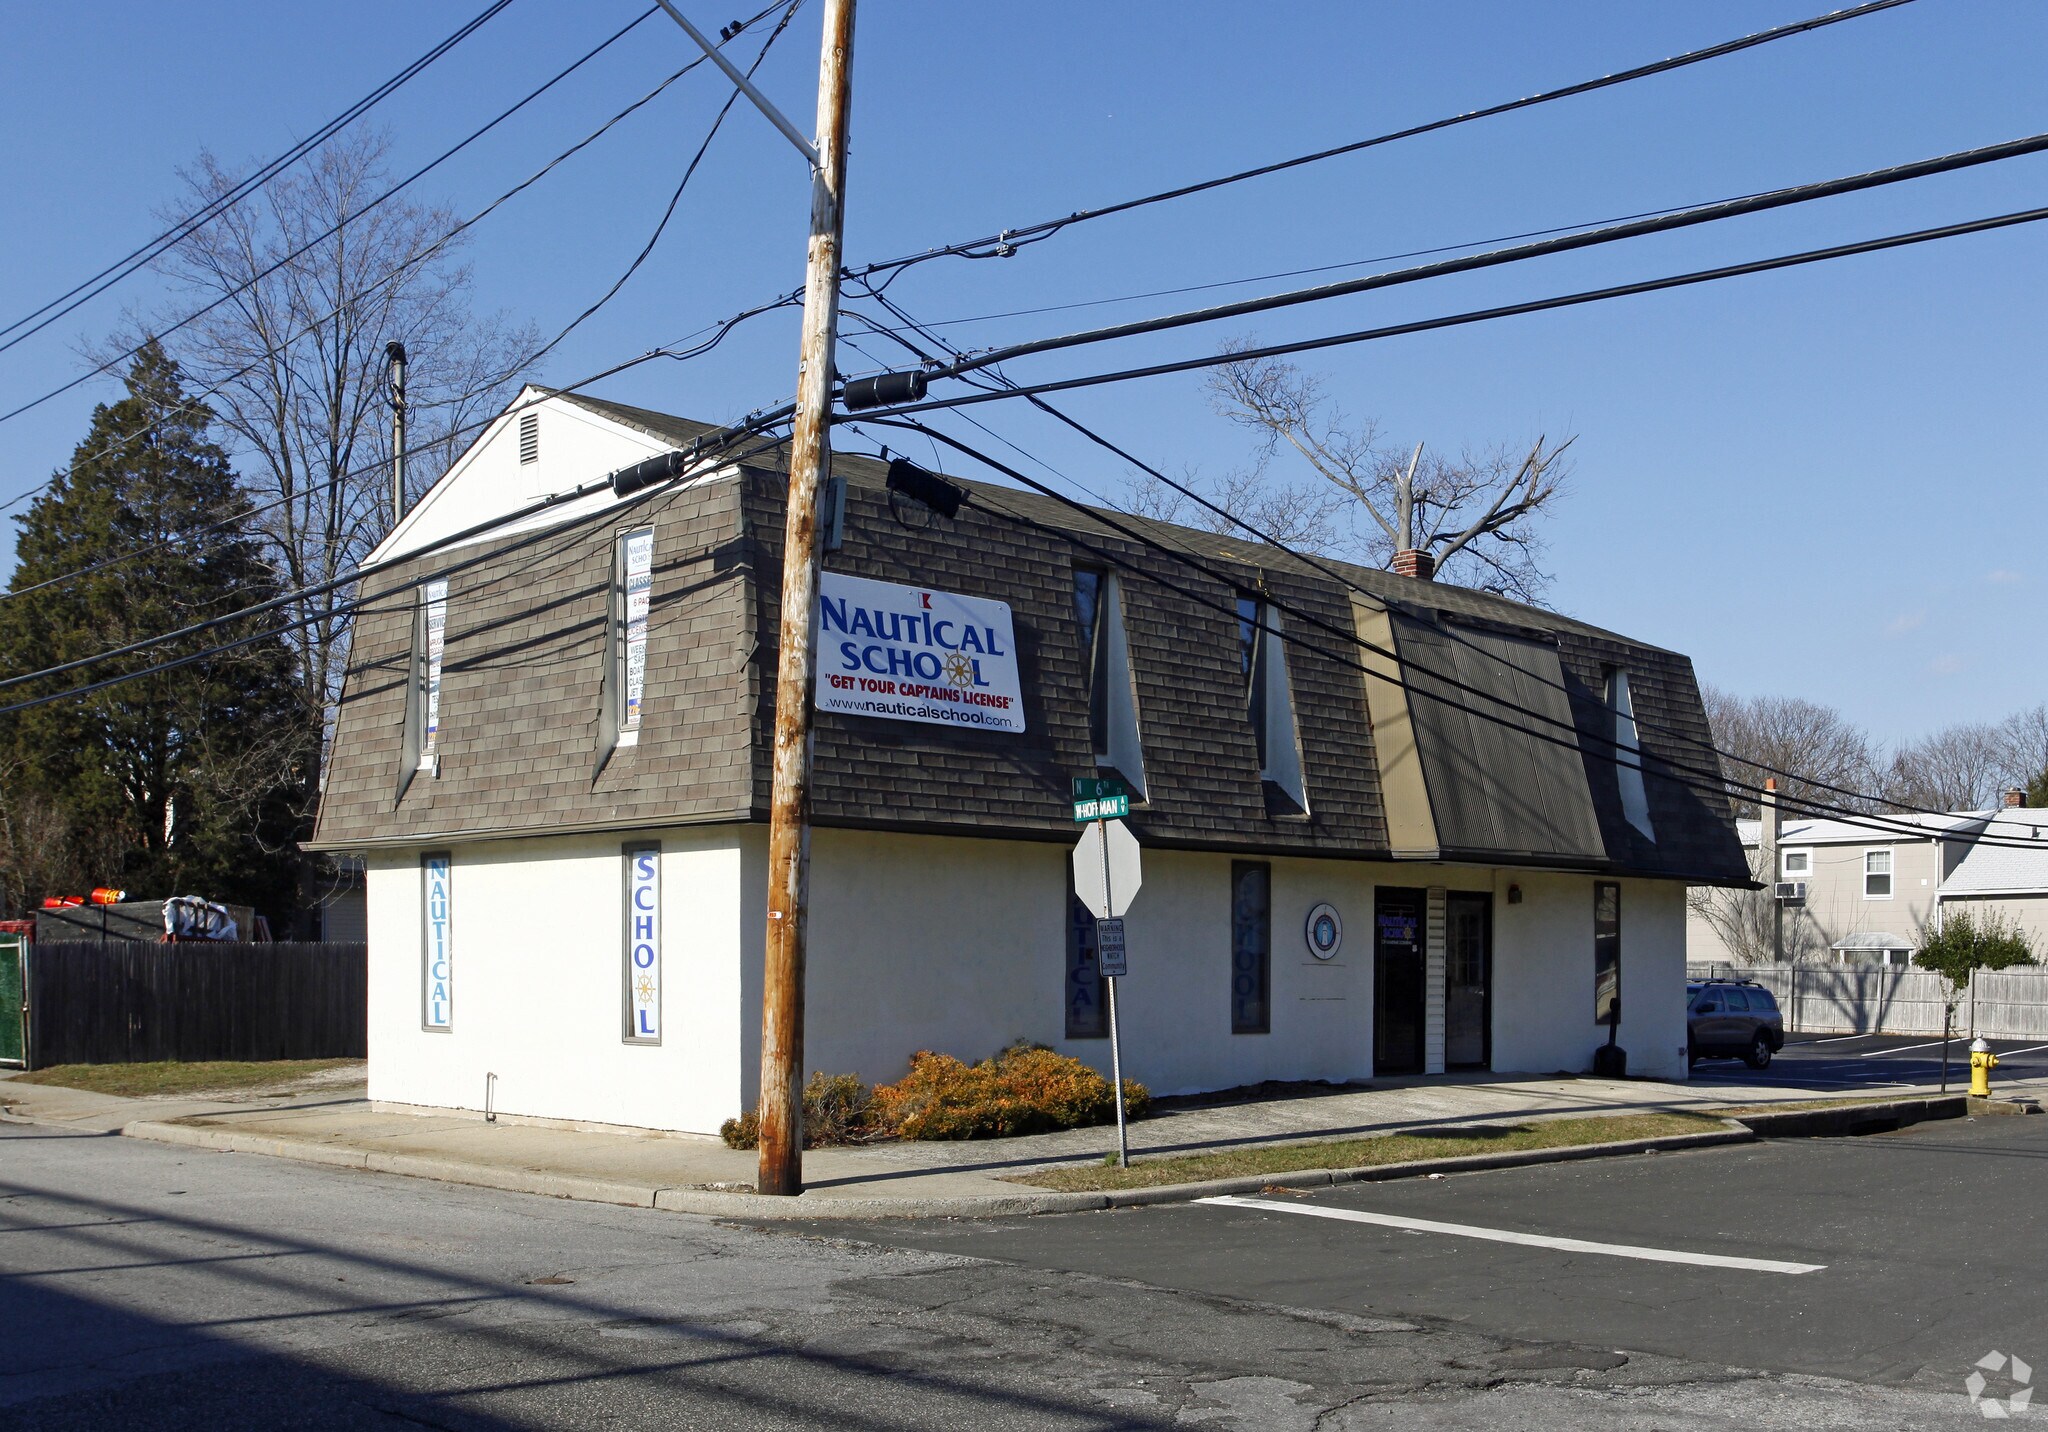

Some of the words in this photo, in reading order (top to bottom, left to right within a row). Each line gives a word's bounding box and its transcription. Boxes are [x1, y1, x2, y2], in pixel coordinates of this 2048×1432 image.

[820, 595, 1004, 657] NAUTICAL
[825, 673, 855, 690] "GET
[858, 678, 896, 695] YOUR
[899, 685, 960, 703] CAPTAINS
[962, 696, 1014, 710] LICENSE"
[829, 698, 1012, 728] www.nauticalschool.com
[1076, 780, 1082, 795] N
[430, 862, 448, 1024] NAUTICAL
[1070, 898, 1094, 1025] UTICAL
[1235, 878, 1255, 1020] CHOOL
